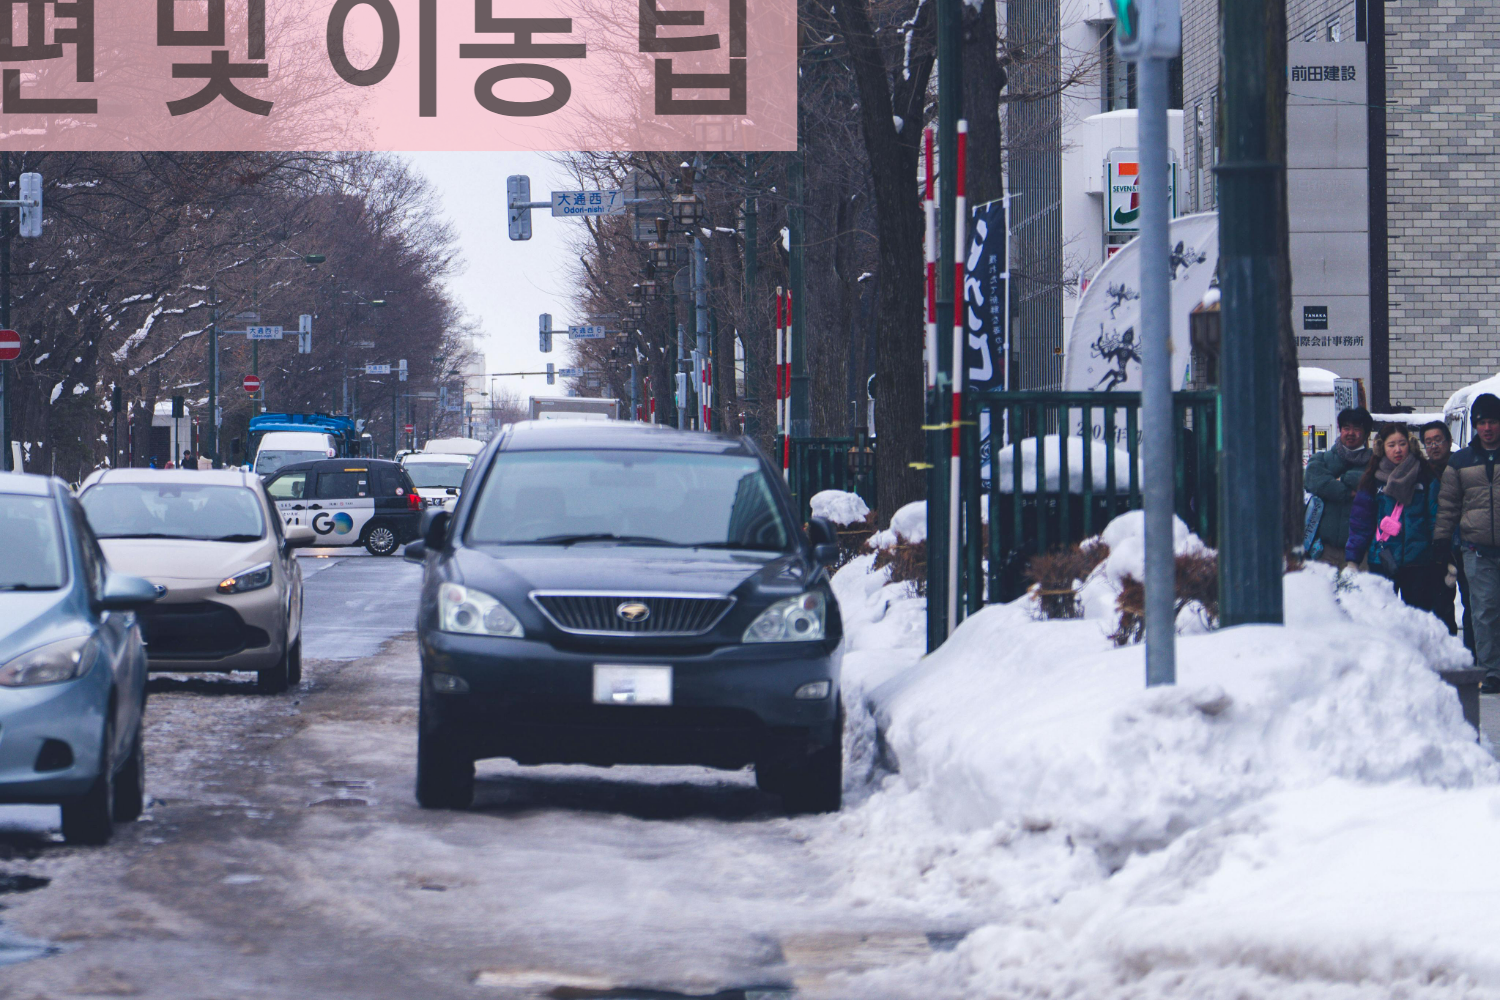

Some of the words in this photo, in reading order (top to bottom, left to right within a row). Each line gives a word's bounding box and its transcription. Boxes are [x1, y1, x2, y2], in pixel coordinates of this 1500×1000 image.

[1291, 64, 1356, 82] 前田建設
[557, 192, 602, 206] 大通西
[608, 191, 617, 205] 7
[563, 205, 605, 214] Odori-nishi
